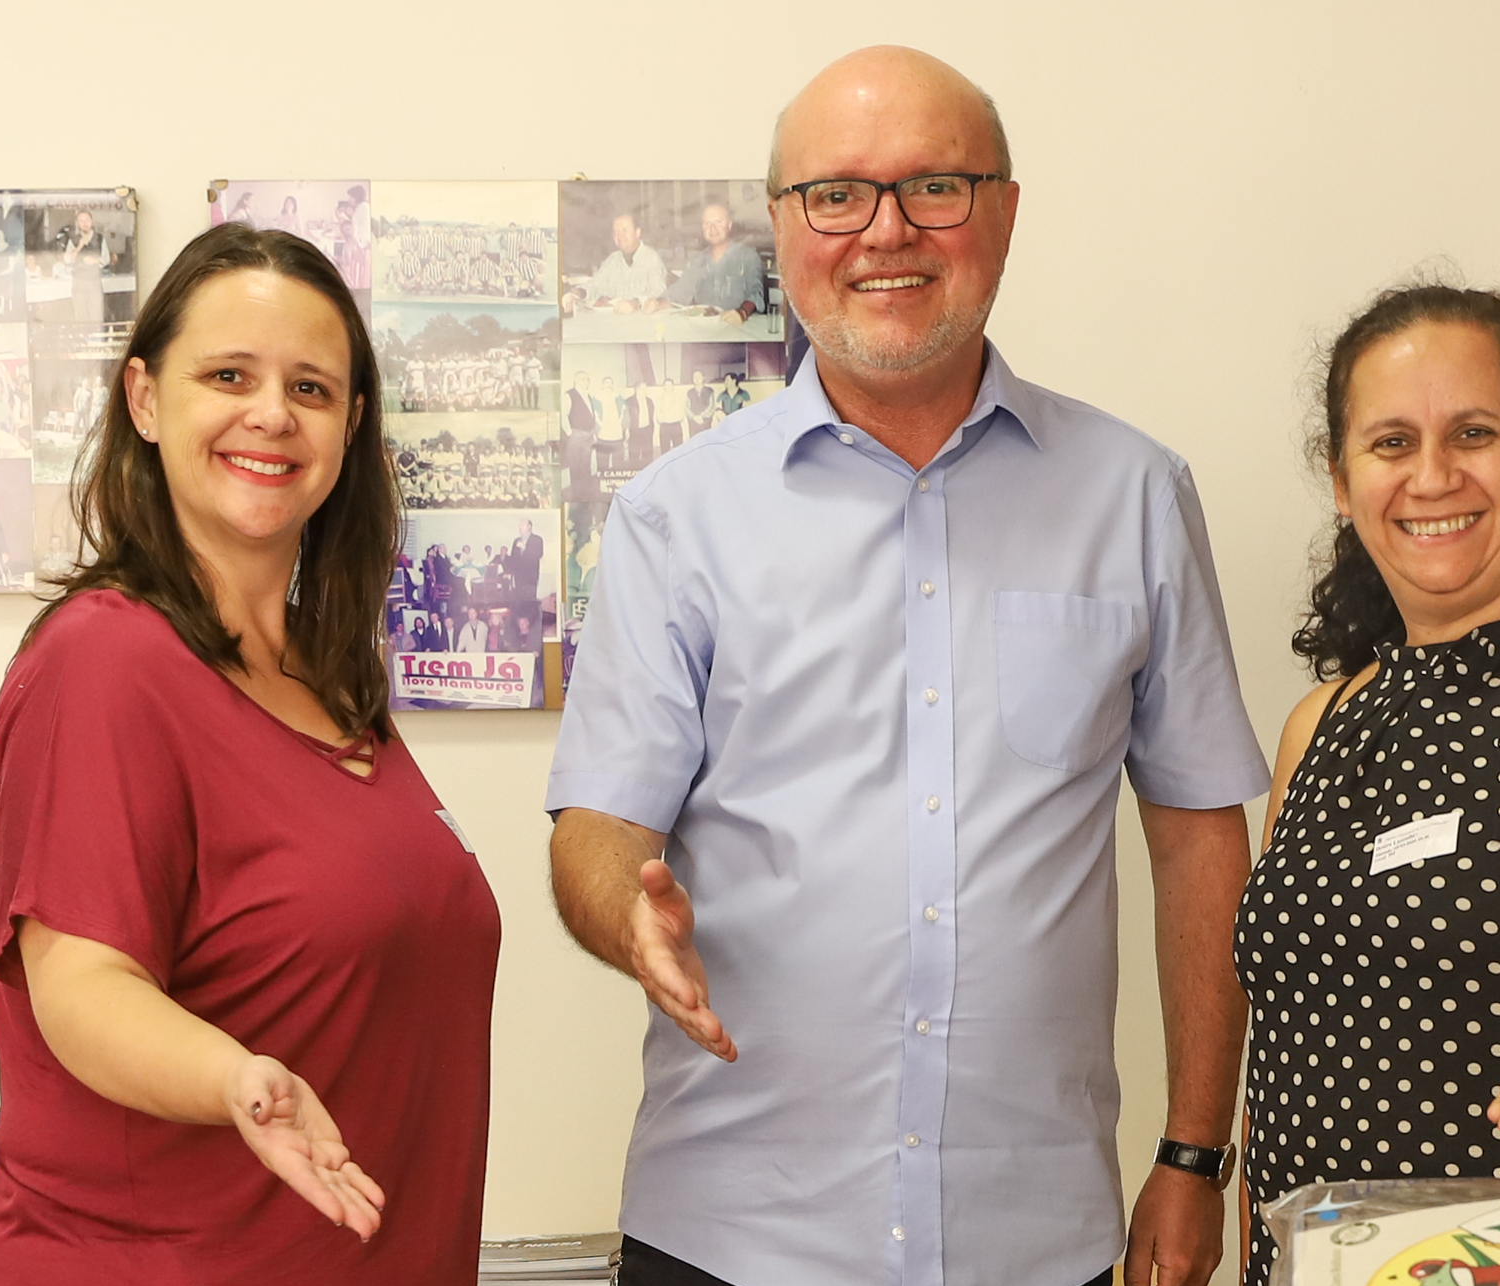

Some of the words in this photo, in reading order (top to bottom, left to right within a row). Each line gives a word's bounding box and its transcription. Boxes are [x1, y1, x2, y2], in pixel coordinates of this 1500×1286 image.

[399, 655, 473, 678] Trem
[484, 656, 522, 680] Já
[402, 676, 435, 687] Novo
[439, 676, 525, 695] Hamburgo
